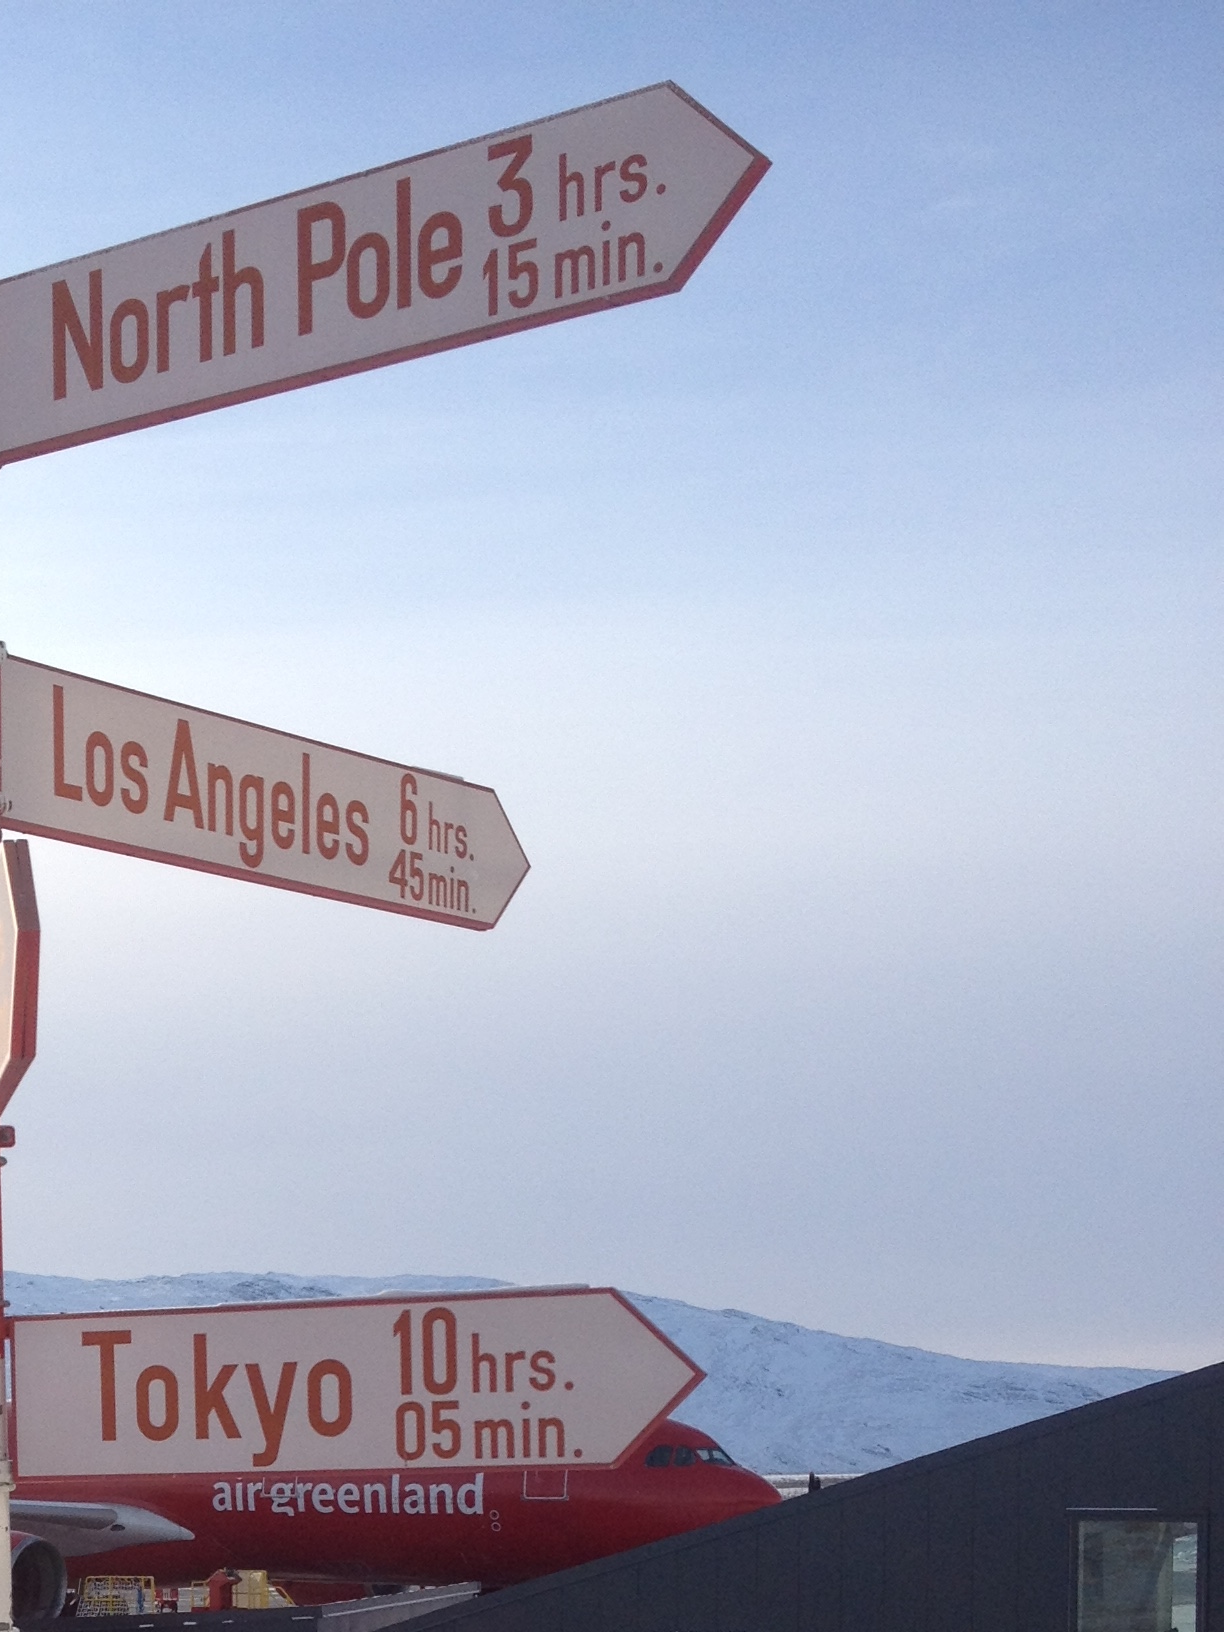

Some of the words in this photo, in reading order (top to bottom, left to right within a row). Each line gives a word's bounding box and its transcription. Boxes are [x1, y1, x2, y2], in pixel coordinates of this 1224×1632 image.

[52, 228, 265, 401] North
[297, 176, 464, 337] Pole
[486, 133, 534, 238] 3
[557, 152, 668, 222] hrs.
[482, 240, 540, 316] 15
[554, 220, 666, 300] min.
[52, 684, 150, 815] Los
[163, 718, 370, 869] Angeles
[399, 772, 418, 846] 6
[427, 802, 475, 861] hrs.
[387, 848, 424, 902] 45
[427, 866, 477, 914] min.
[81, 1329, 354, 1468] Tokyo
[392, 1307, 458, 1397] 10
[471, 1334, 576, 1394] hrs.
[394, 1400, 463, 1462] 05
[474, 1401, 583, 1461] min.
[212, 1476, 261, 1513] air
[268, 1472, 485, 1517] greenland
